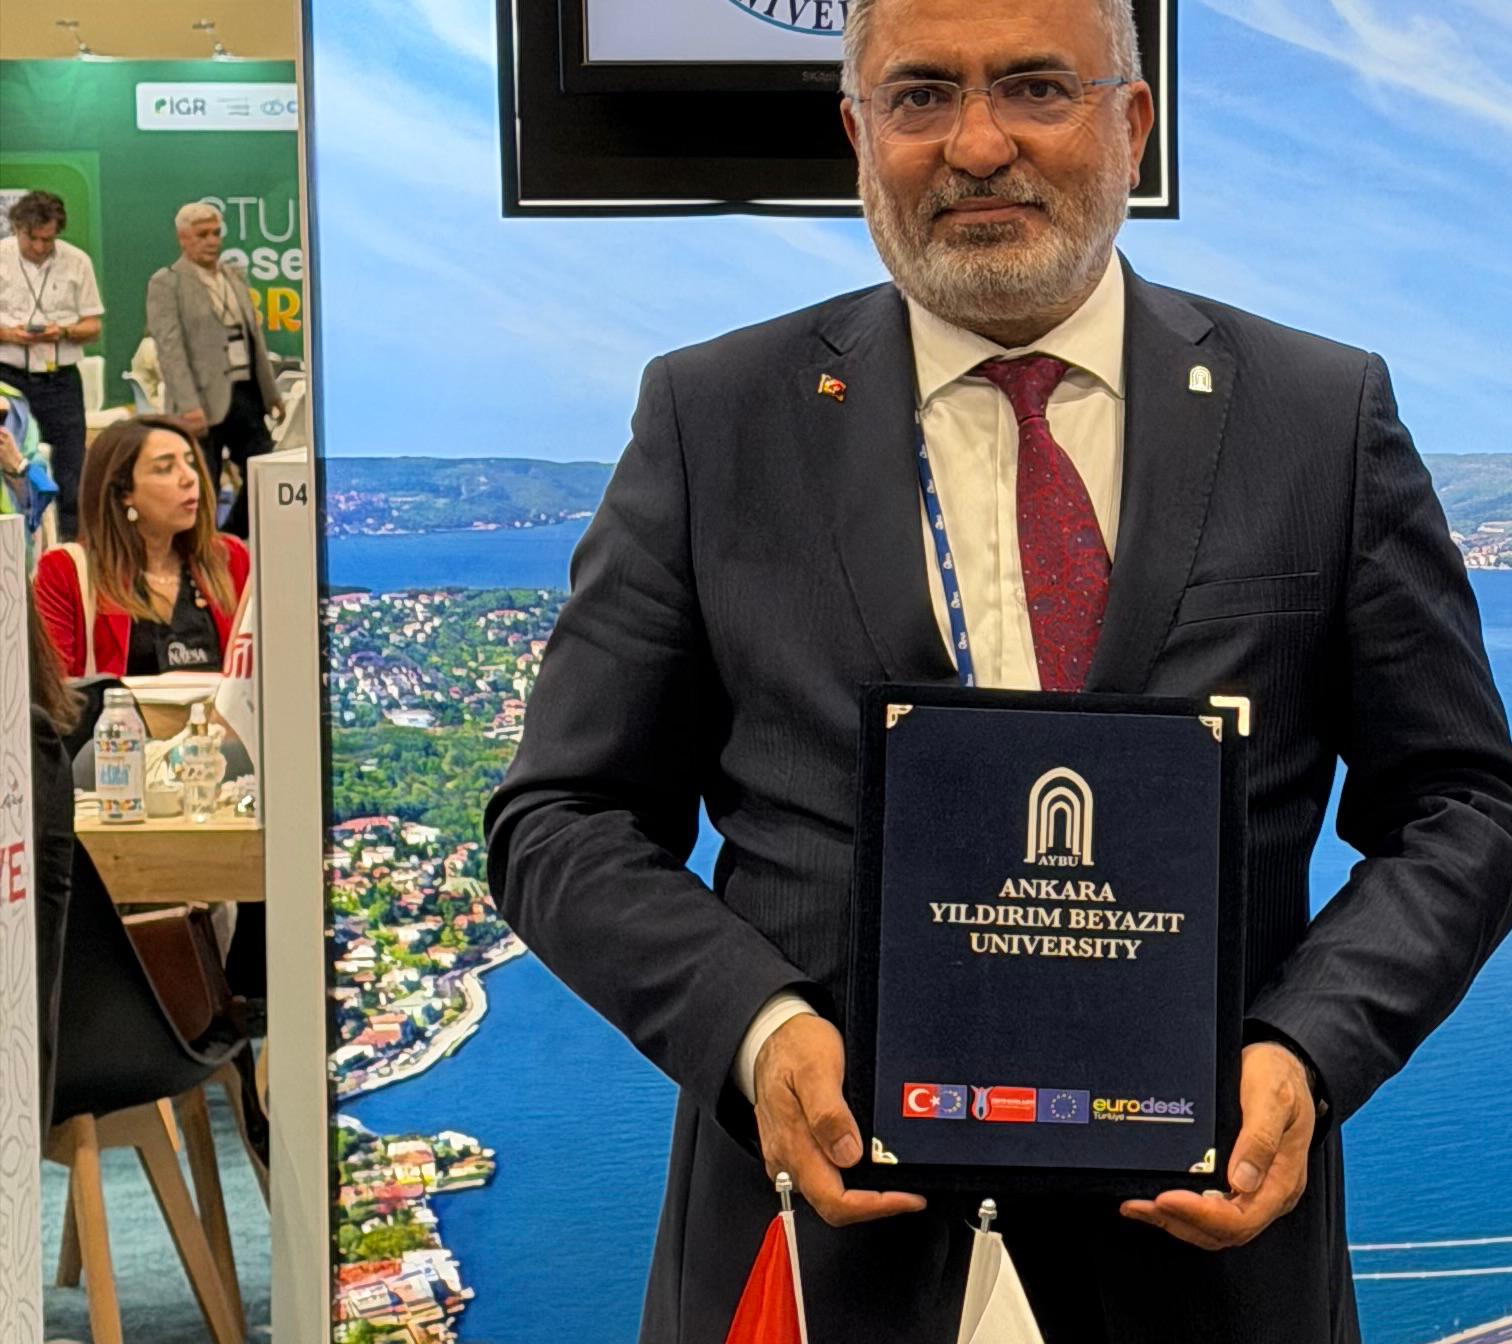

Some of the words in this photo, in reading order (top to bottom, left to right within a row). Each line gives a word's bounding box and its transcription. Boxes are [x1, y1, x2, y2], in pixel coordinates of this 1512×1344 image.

[278, 482, 307, 506] D4
[1037, 855, 1080, 867] AYBU
[998, 877, 1116, 902] ANKARA
[929, 902, 1062, 929] YILDIRIM
[1068, 908, 1185, 933] BEYAZIT
[969, 932, 1143, 959] UNIVERSITY
[1092, 1097, 1194, 1116] eurodesk
